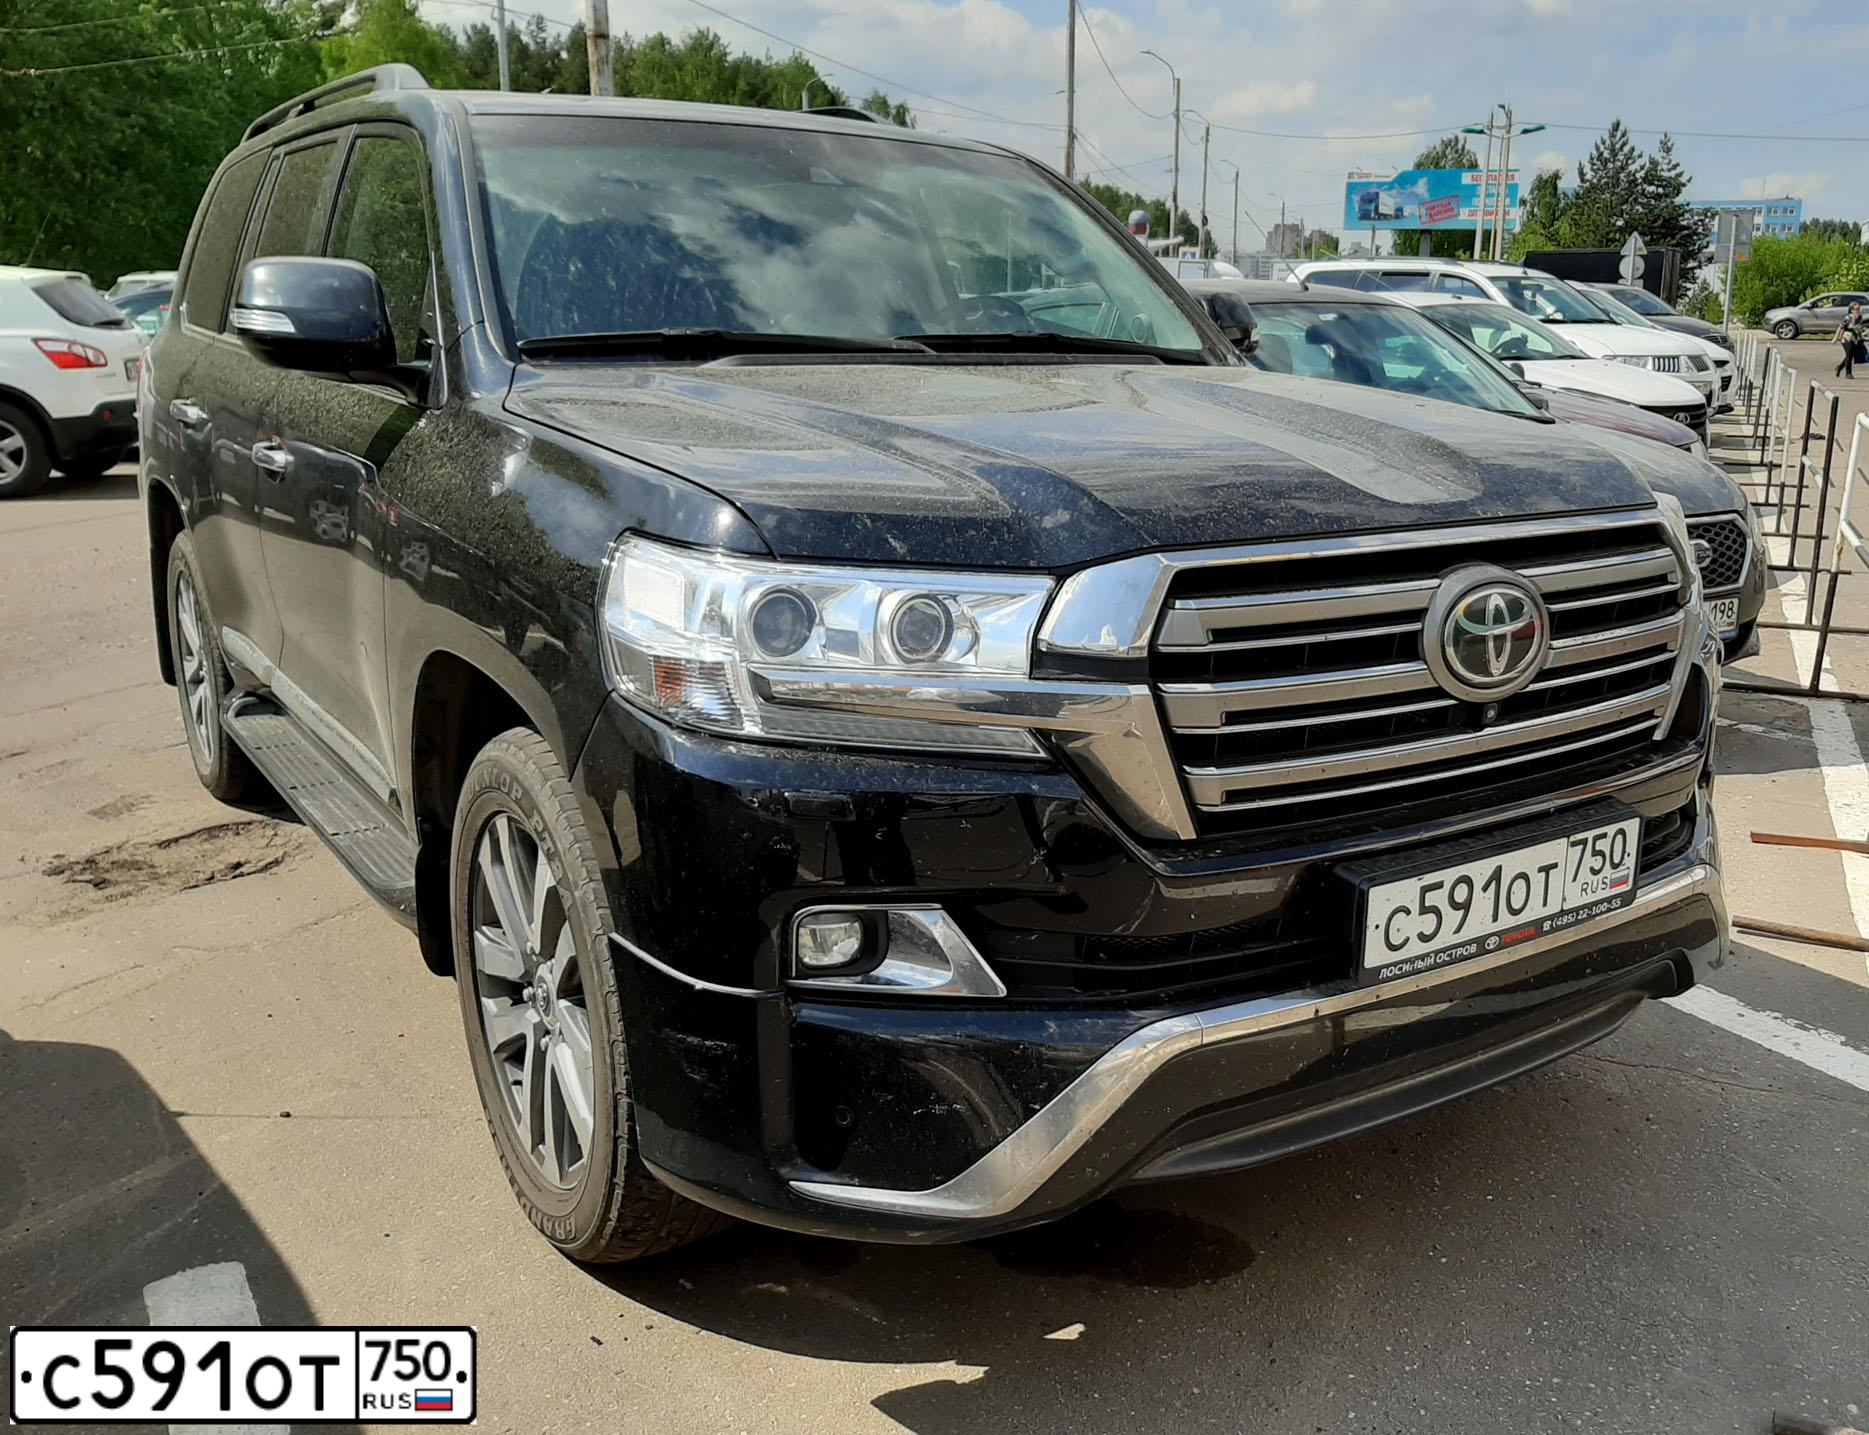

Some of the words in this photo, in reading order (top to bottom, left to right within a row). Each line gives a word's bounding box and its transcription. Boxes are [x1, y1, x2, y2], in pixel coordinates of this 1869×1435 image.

[1711, 600, 1734, 621] 198
[1569, 827, 1627, 883] 750
[1580, 879, 1609, 898] RUS
[1378, 953, 1434, 980] ЛОСИНЫЙ
[1436, 942, 1477, 964] ОСТРОВ
[1552, 911, 1577, 929] (495)
[1578, 897, 1622, 920] 22-100-55
